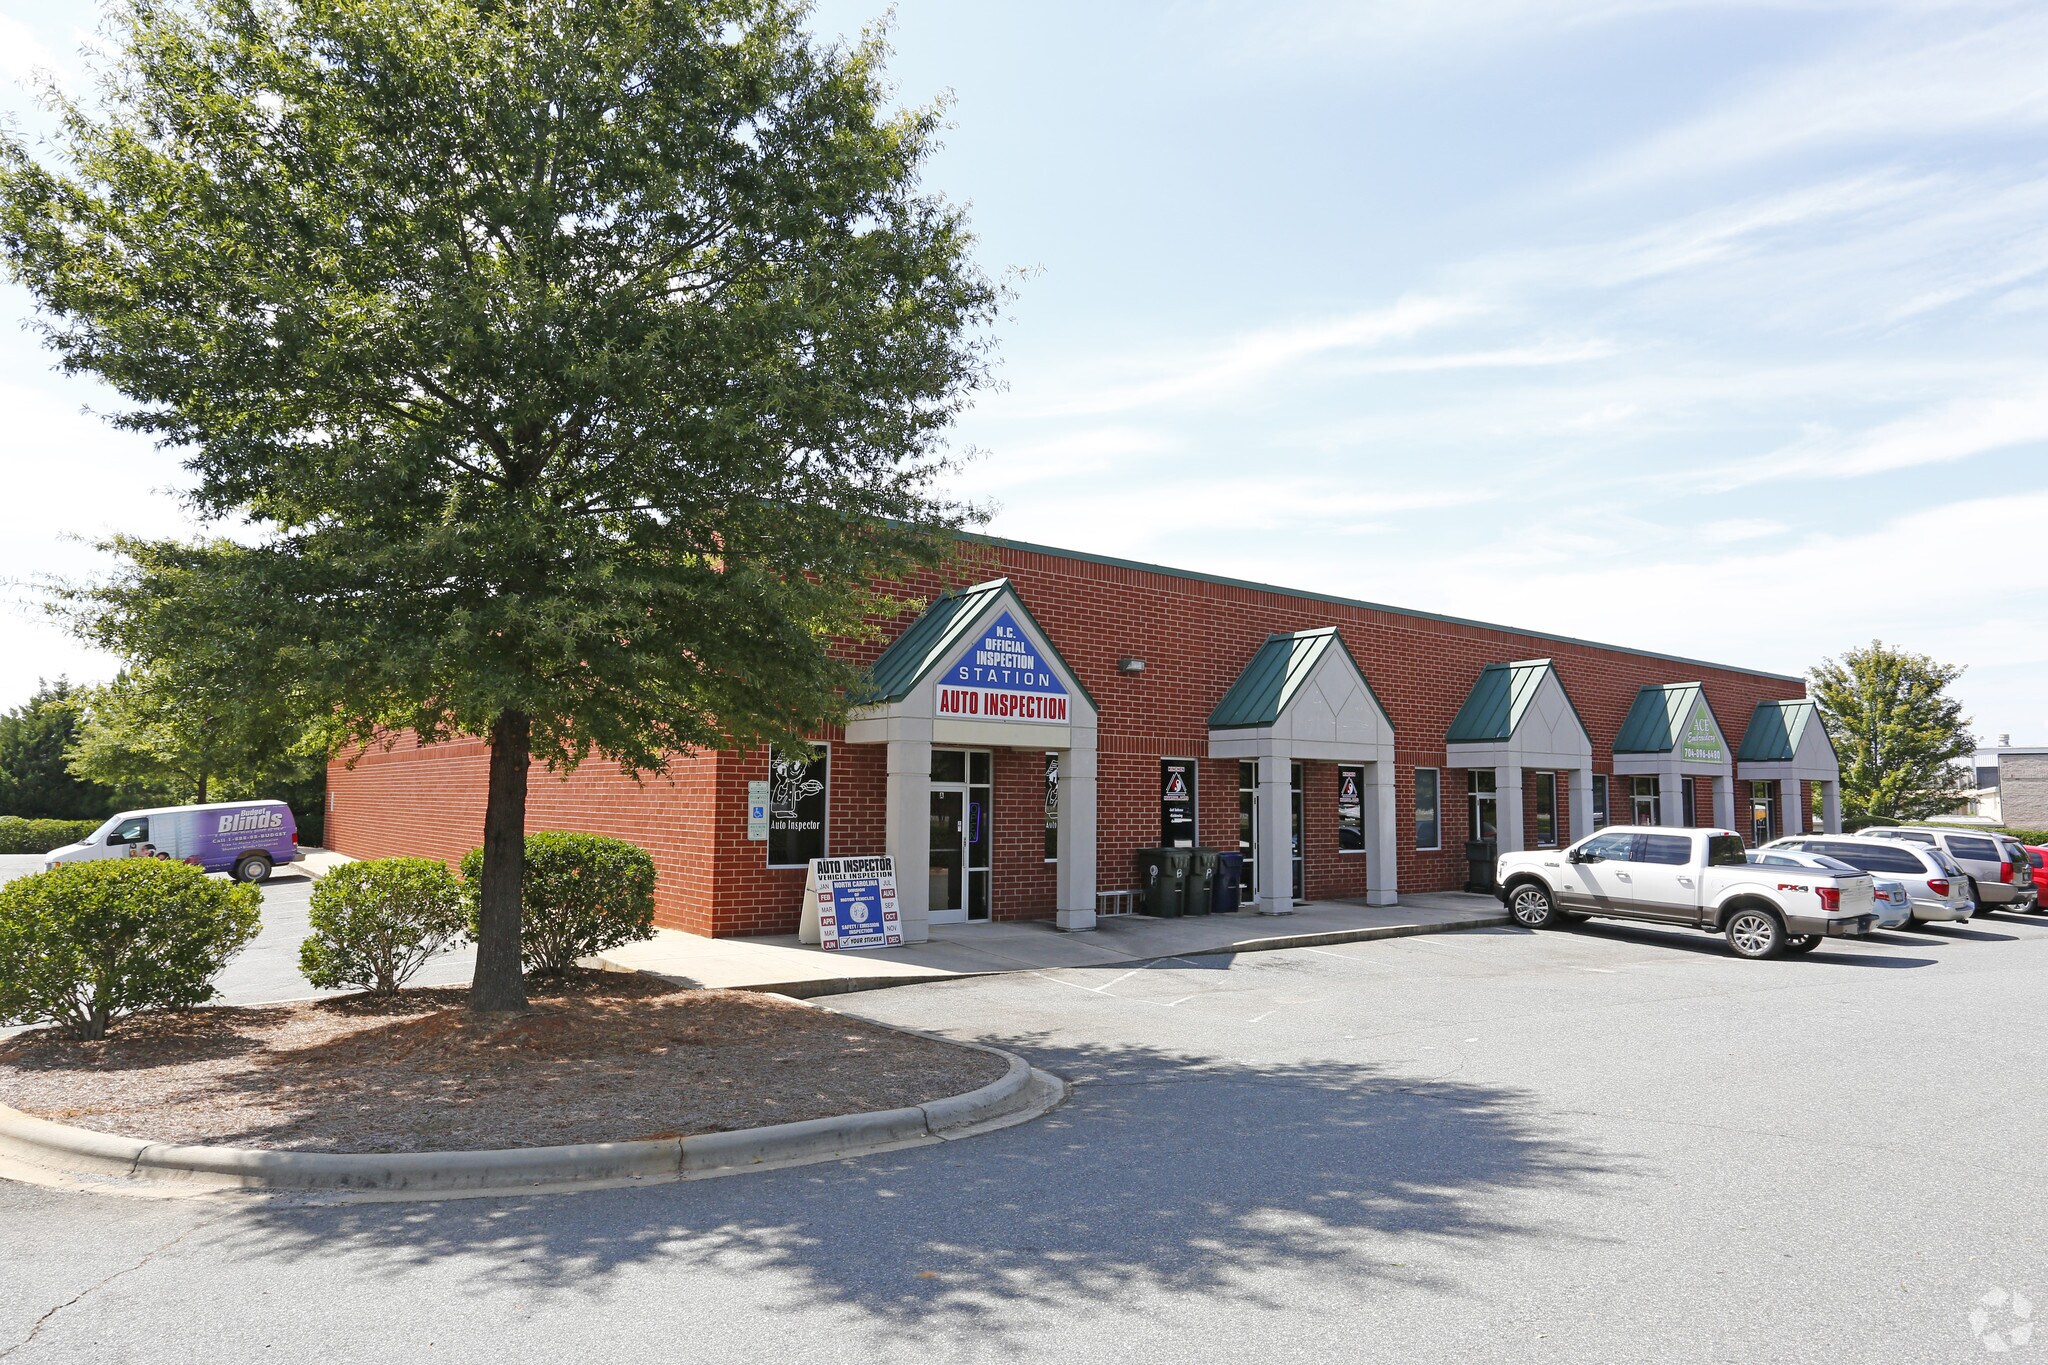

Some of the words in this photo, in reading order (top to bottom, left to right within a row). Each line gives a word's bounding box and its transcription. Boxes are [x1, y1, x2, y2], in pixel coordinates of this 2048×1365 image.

[996, 626, 1016, 638] N.C.
[985, 638, 1026, 653] OFFICIAL
[976, 650, 1034, 669] INSPECTION
[959, 666, 1050, 687] STATION
[940, 689, 979, 715] AUTO
[984, 692, 1066, 720] INSPECTION
[1693, 718, 1710, 732] ACE
[241, 808, 266, 817] Budget
[218, 810, 283, 833] Blinds
[770, 819, 787, 830] Auto
[788, 819, 820, 831] Inspector
[969, 804, 978, 841] OPEN
[817, 860, 841, 874] AUTO
[843, 857, 892, 873] INSPECTOR
[818, 873, 847, 881] VEHICLE
[849, 871, 893, 880] INSPECTION
[834, 880, 852, 889] NORTH
[853, 879, 878, 888] CAROLINA
[1777, 883, 1809, 892] FX4
[883, 889, 894, 897] AUG
[864, 936, 883, 944] STICKER
